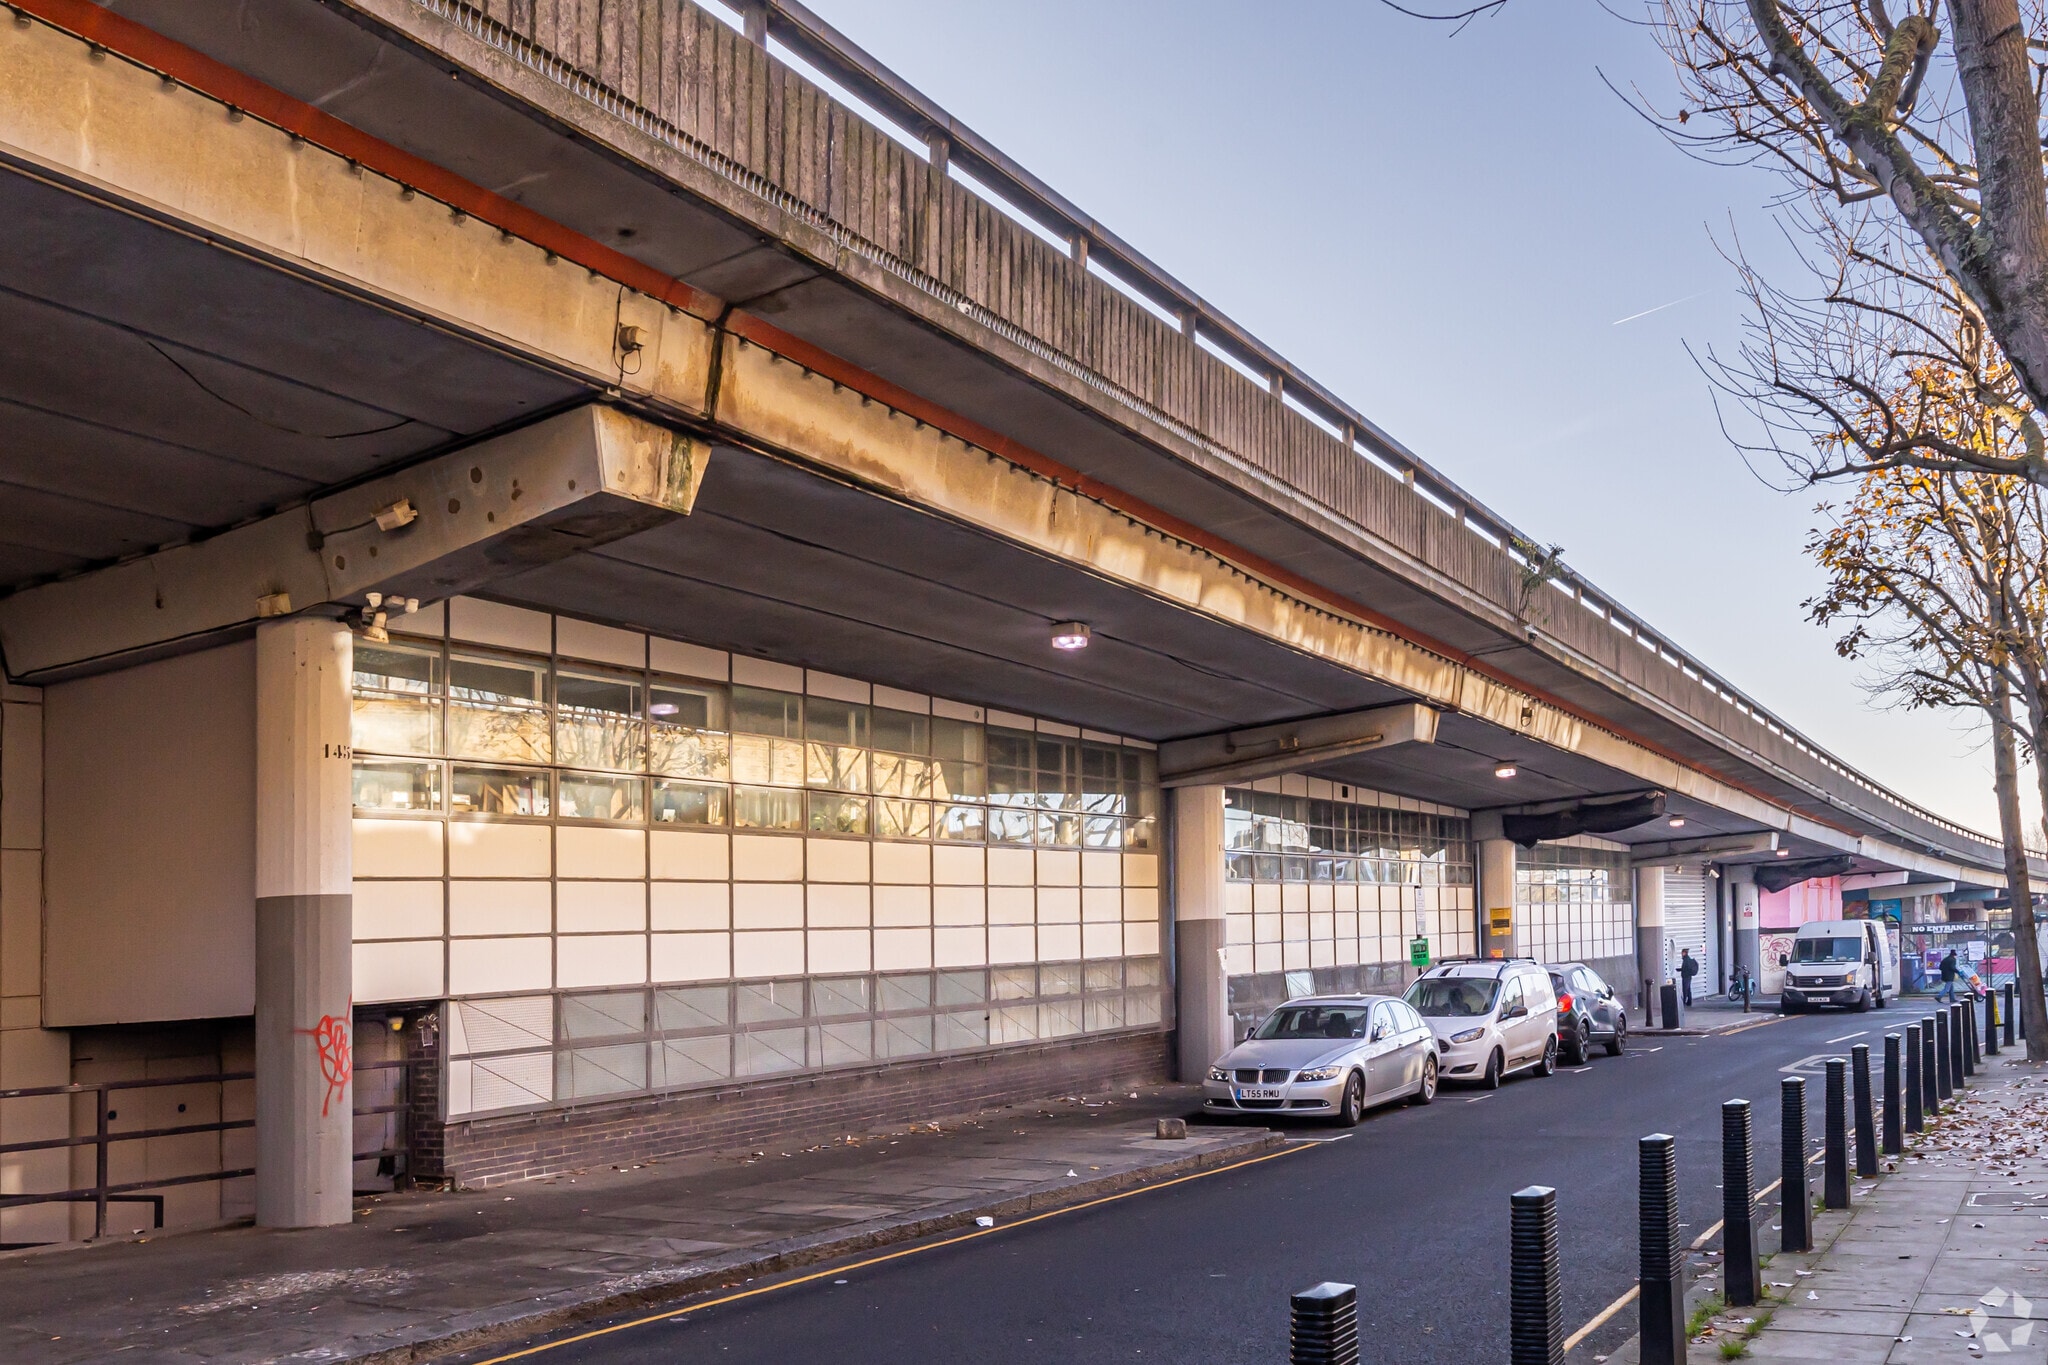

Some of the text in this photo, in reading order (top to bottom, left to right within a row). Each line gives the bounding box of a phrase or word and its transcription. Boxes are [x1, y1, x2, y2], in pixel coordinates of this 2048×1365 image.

[1926, 924, 1975, 932] ENTRANCE
[1241, 1089, 1280, 1098] LT55 RMU
